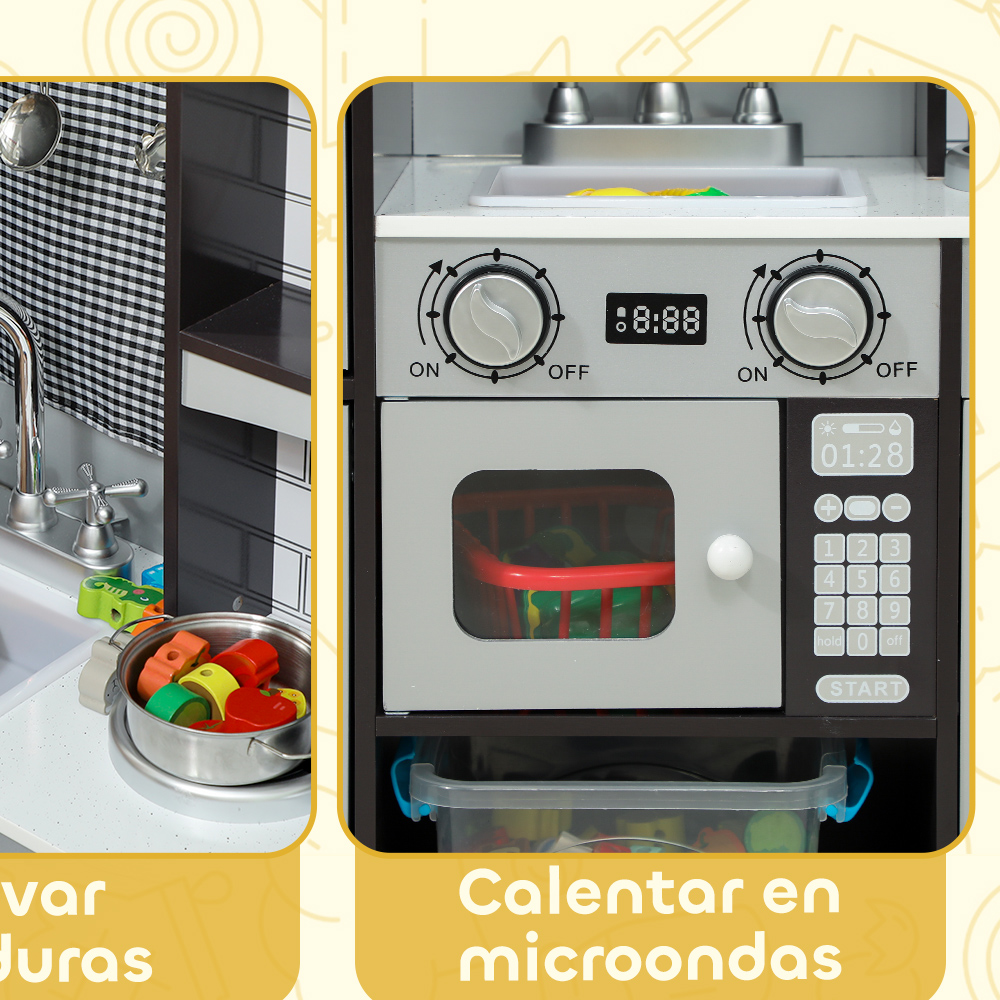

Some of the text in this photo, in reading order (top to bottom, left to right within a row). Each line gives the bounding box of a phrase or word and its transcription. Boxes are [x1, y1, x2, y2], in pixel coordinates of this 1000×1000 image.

[409, 361, 440, 378] ON
[548, 364, 590, 380] OFF
[737, 366, 768, 382] ON
[876, 361, 918, 378] OFF
[821, 442, 904, 468] 01:28
[824, 539, 900, 557] 1 2 3
[823, 570, 900, 588] 4 5 6
[823, 601, 900, 619] 7 8 9
[817, 633, 903, 650] hold 0 off
[830, 681, 902, 697] START
